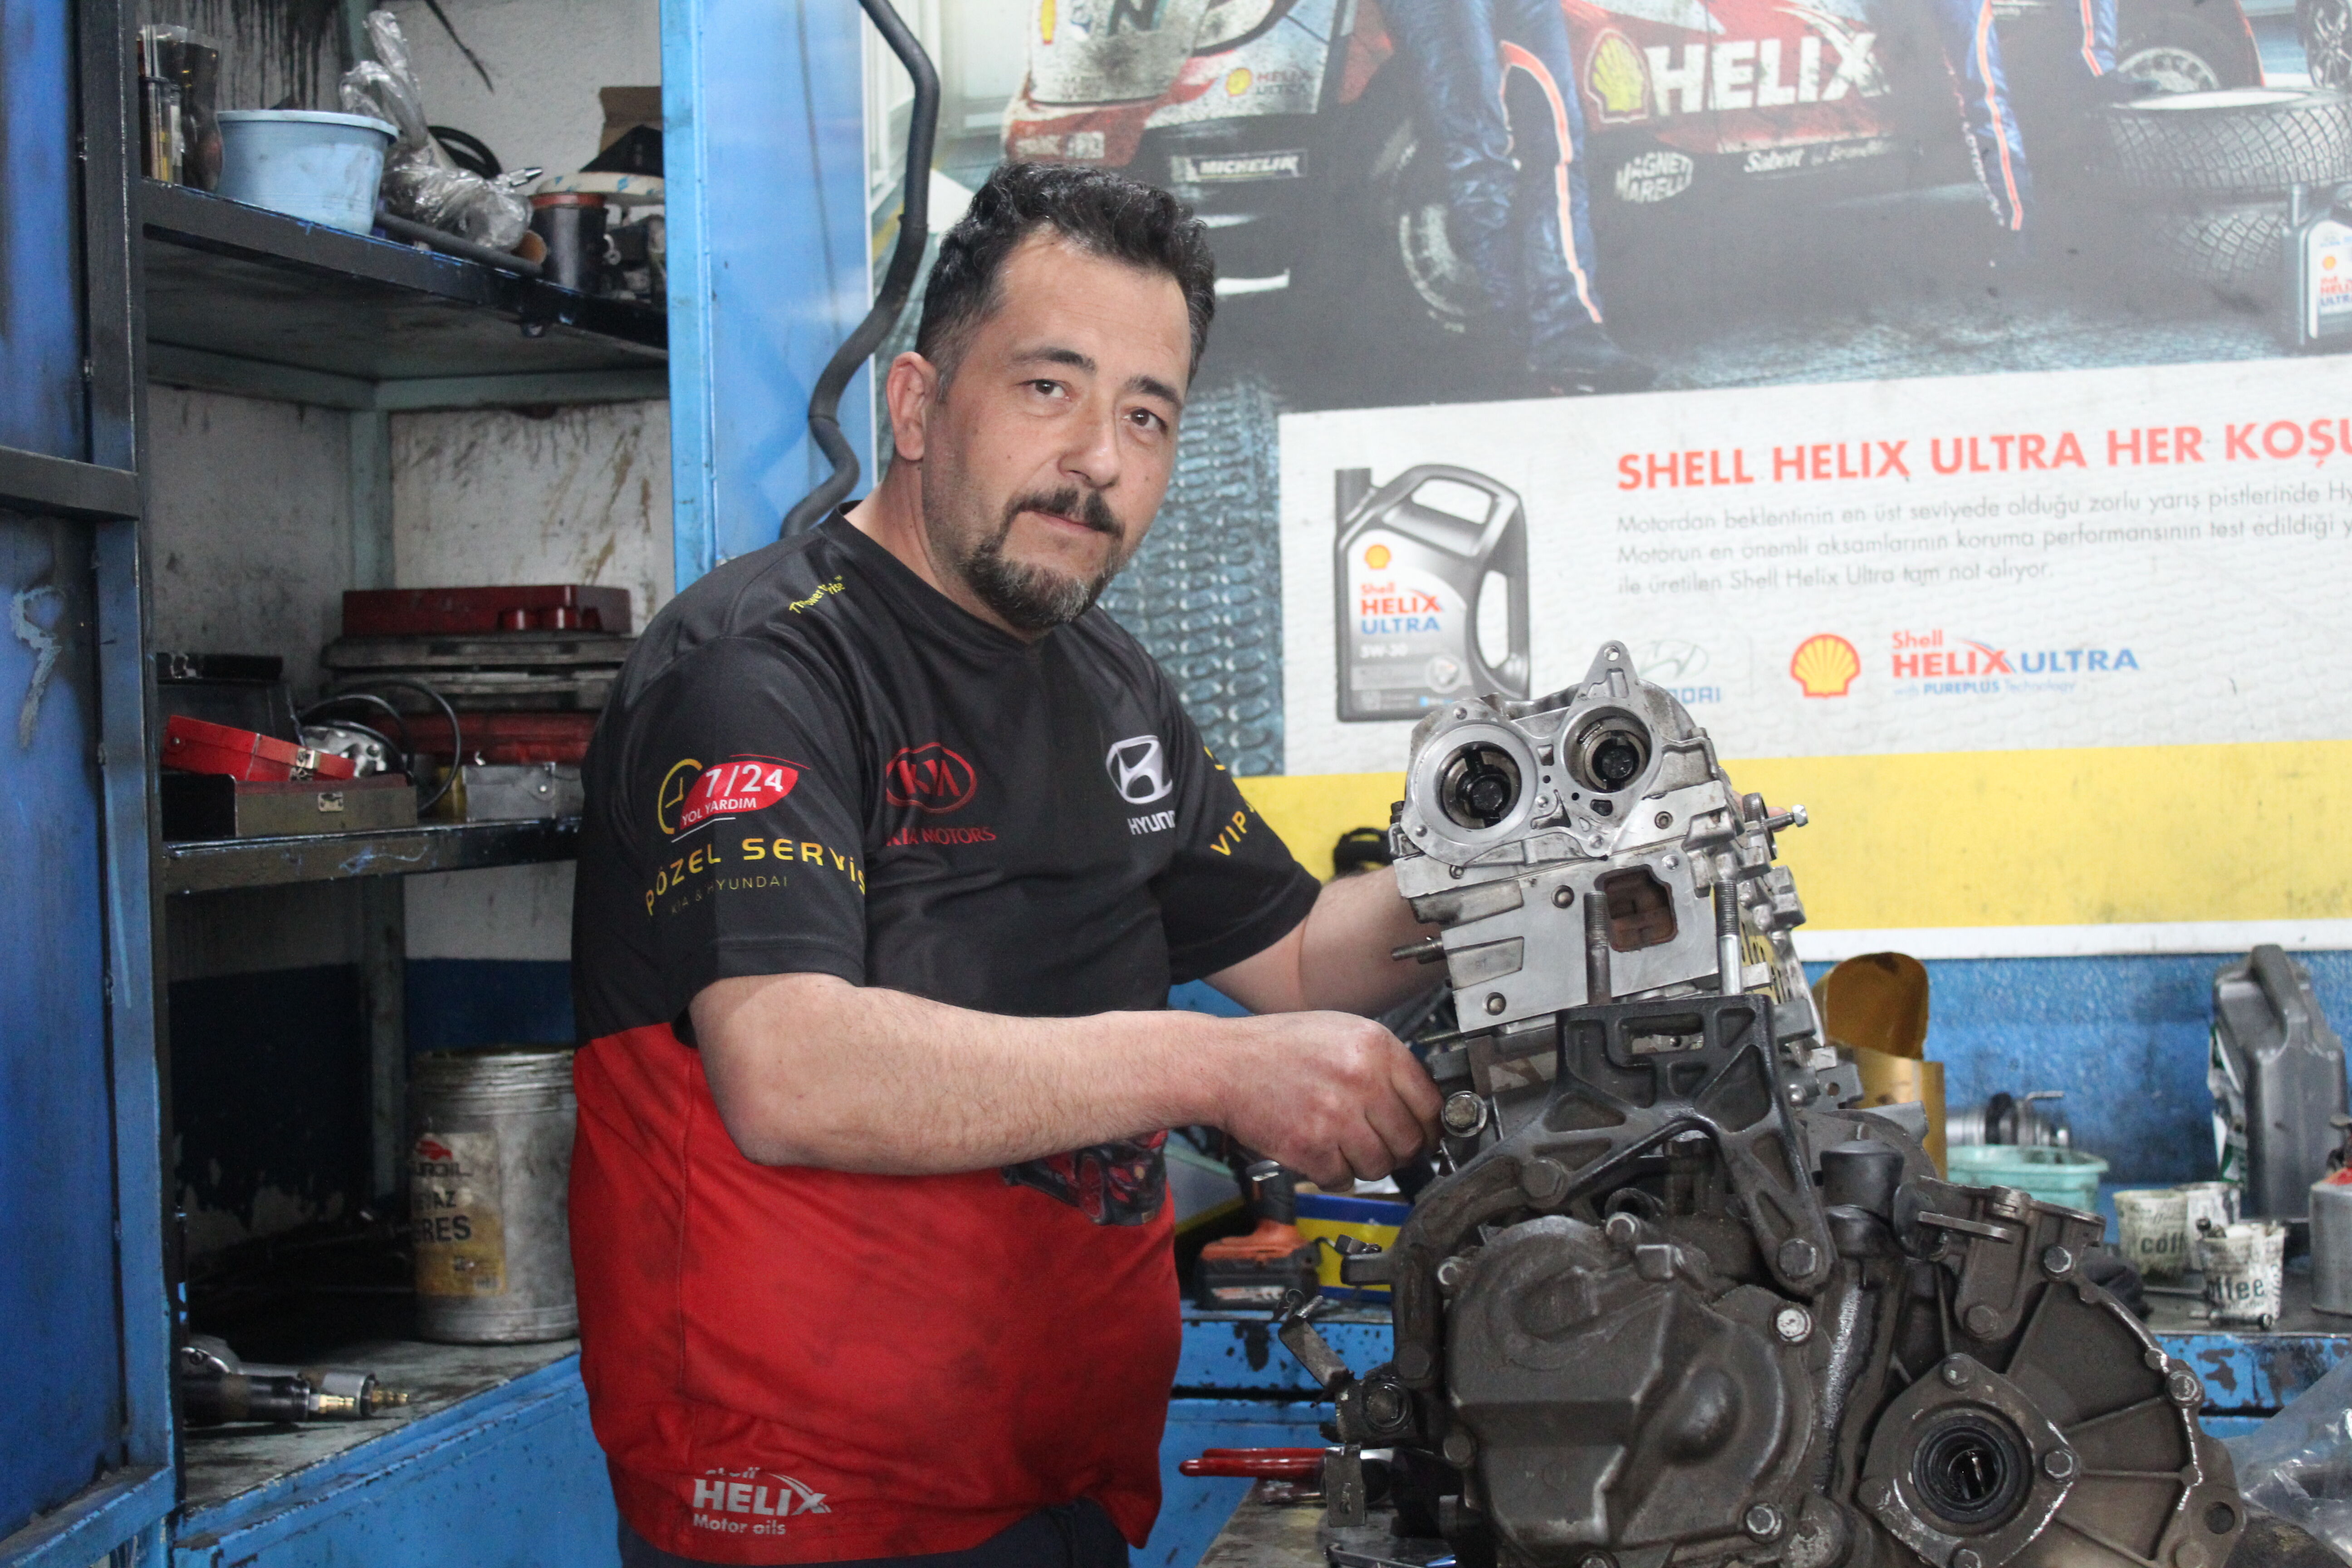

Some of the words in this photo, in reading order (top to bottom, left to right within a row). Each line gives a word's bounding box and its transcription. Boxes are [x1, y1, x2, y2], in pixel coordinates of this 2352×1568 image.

[1643, 7, 1891, 117] HELIX
[1617, 449, 1754, 490] SHELL
[1773, 440, 1911, 482] HELIX
[1930, 432, 2088, 475] ULTRA
[2107, 426, 2205, 466] HER
[1617, 511, 1716, 534] Motordan
[1725, 506, 1834, 529] beklentinin
[1842, 508, 1866, 523] en
[1874, 501, 1902, 522] üst
[1910, 497, 1999, 524] seviyede
[2008, 494, 2080, 519] olduğu
[2089, 491, 2140, 513] zorlu
[2149, 492, 2200, 512] yarış
[2209, 483, 2319, 513] pistlerinde
[1617, 545, 1702, 565] Motorun
[1710, 546, 1733, 562] en
[1741, 537, 1809, 560] önemli
[1817, 532, 1948, 556] aksamlarının
[1957, 529, 2034, 549] koruma
[2043, 524, 2201, 550] performansının
[2210, 521, 2245, 537] test
[2253, 514, 2334, 540] edildiği
[1360, 582, 1396, 595] Shell
[1618, 575, 1641, 595] ile
[1649, 570, 1722, 593] üretilen
[1730, 567, 1779, 591] Shell
[1786, 564, 1839, 588] Helix
[1847, 561, 1894, 585] Ultra
[1949, 563, 1981, 581] not
[1360, 588, 1444, 616] HELIX
[1361, 616, 1441, 635] ULTRA
[1892, 629, 1943, 650] Shell
[1892, 638, 2017, 678] HELIX
[2021, 649, 2140, 674] ULTRA
[1924, 681, 2000, 695] PUREPLUS
[706, 764, 784, 798] 7/24
[682, 808, 703, 826] YOL
[705, 797, 757, 814] YARDIM
[921, 827, 997, 845] MOTORS
[1210, 811, 1247, 856] VIP
[706, 876, 788, 895] HYUNDAI
[693, 1473, 832, 1516] HELIX
[693, 1513, 749, 1533] Motor
[753, 1520, 787, 1535] oils
